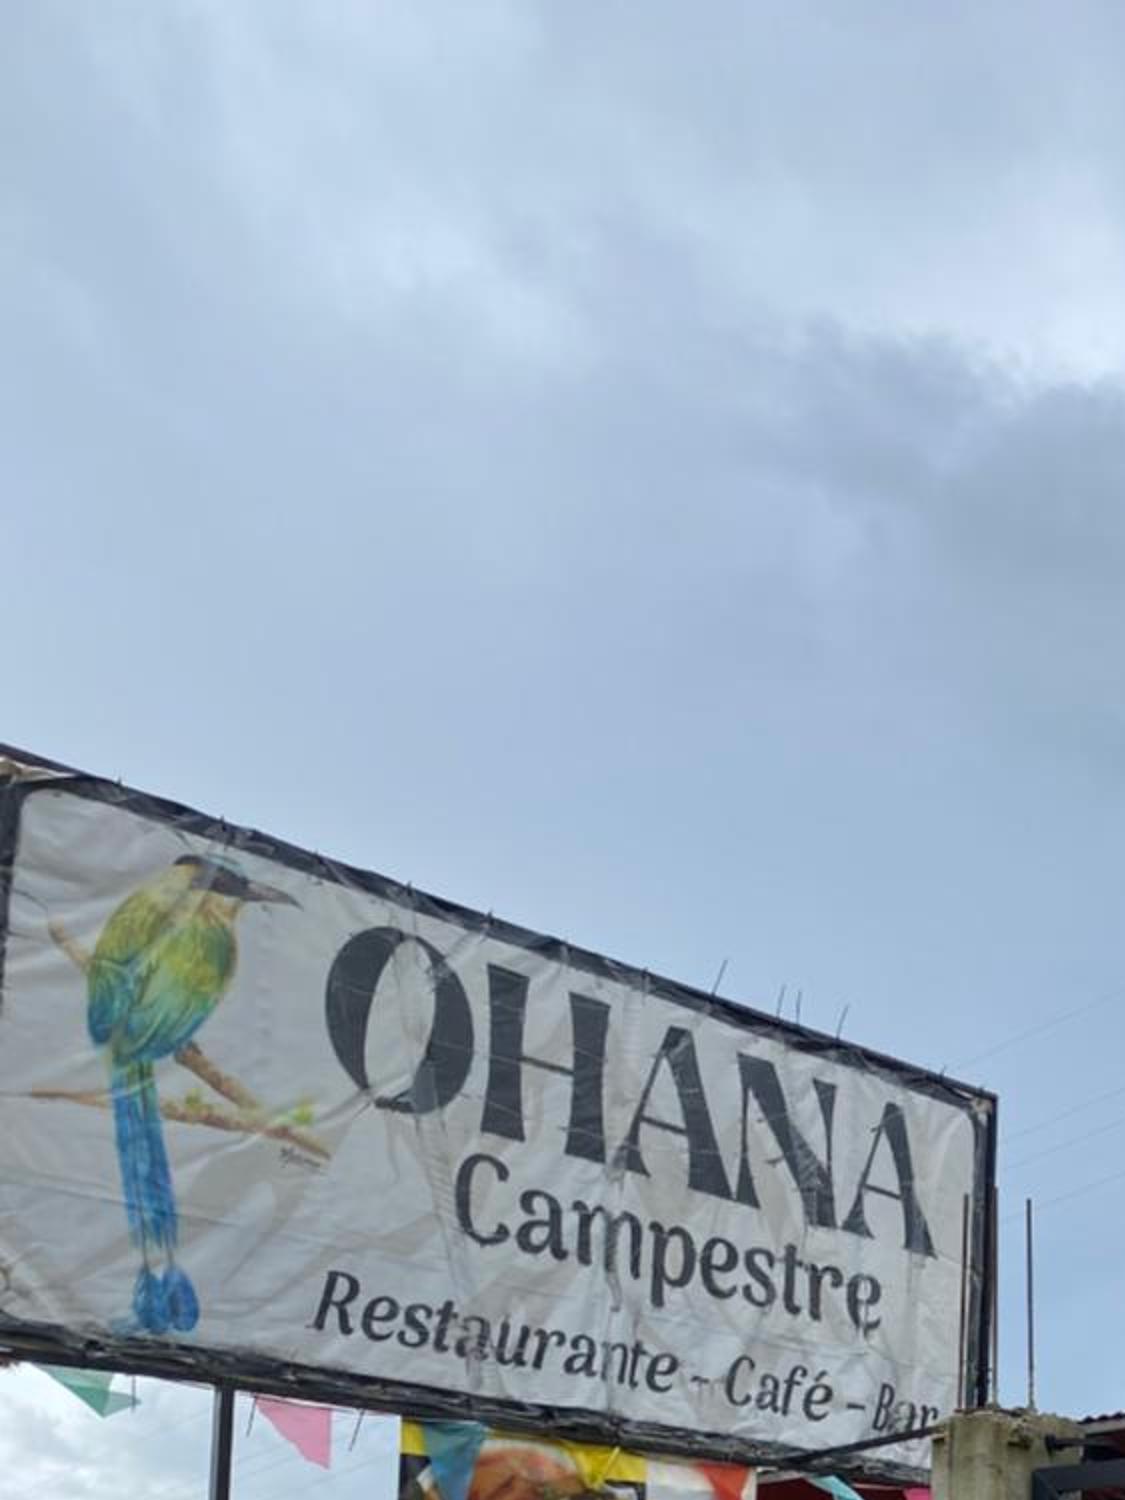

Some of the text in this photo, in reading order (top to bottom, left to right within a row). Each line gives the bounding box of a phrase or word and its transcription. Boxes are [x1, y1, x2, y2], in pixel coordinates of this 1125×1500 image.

[325, 926, 938, 1260] OHANA
[454, 1152, 882, 1333] Campestre
[310, 1270, 679, 1393] Restaurante
[725, 1354, 834, 1422] Café
[872, 1382, 939, 1432] Bar
